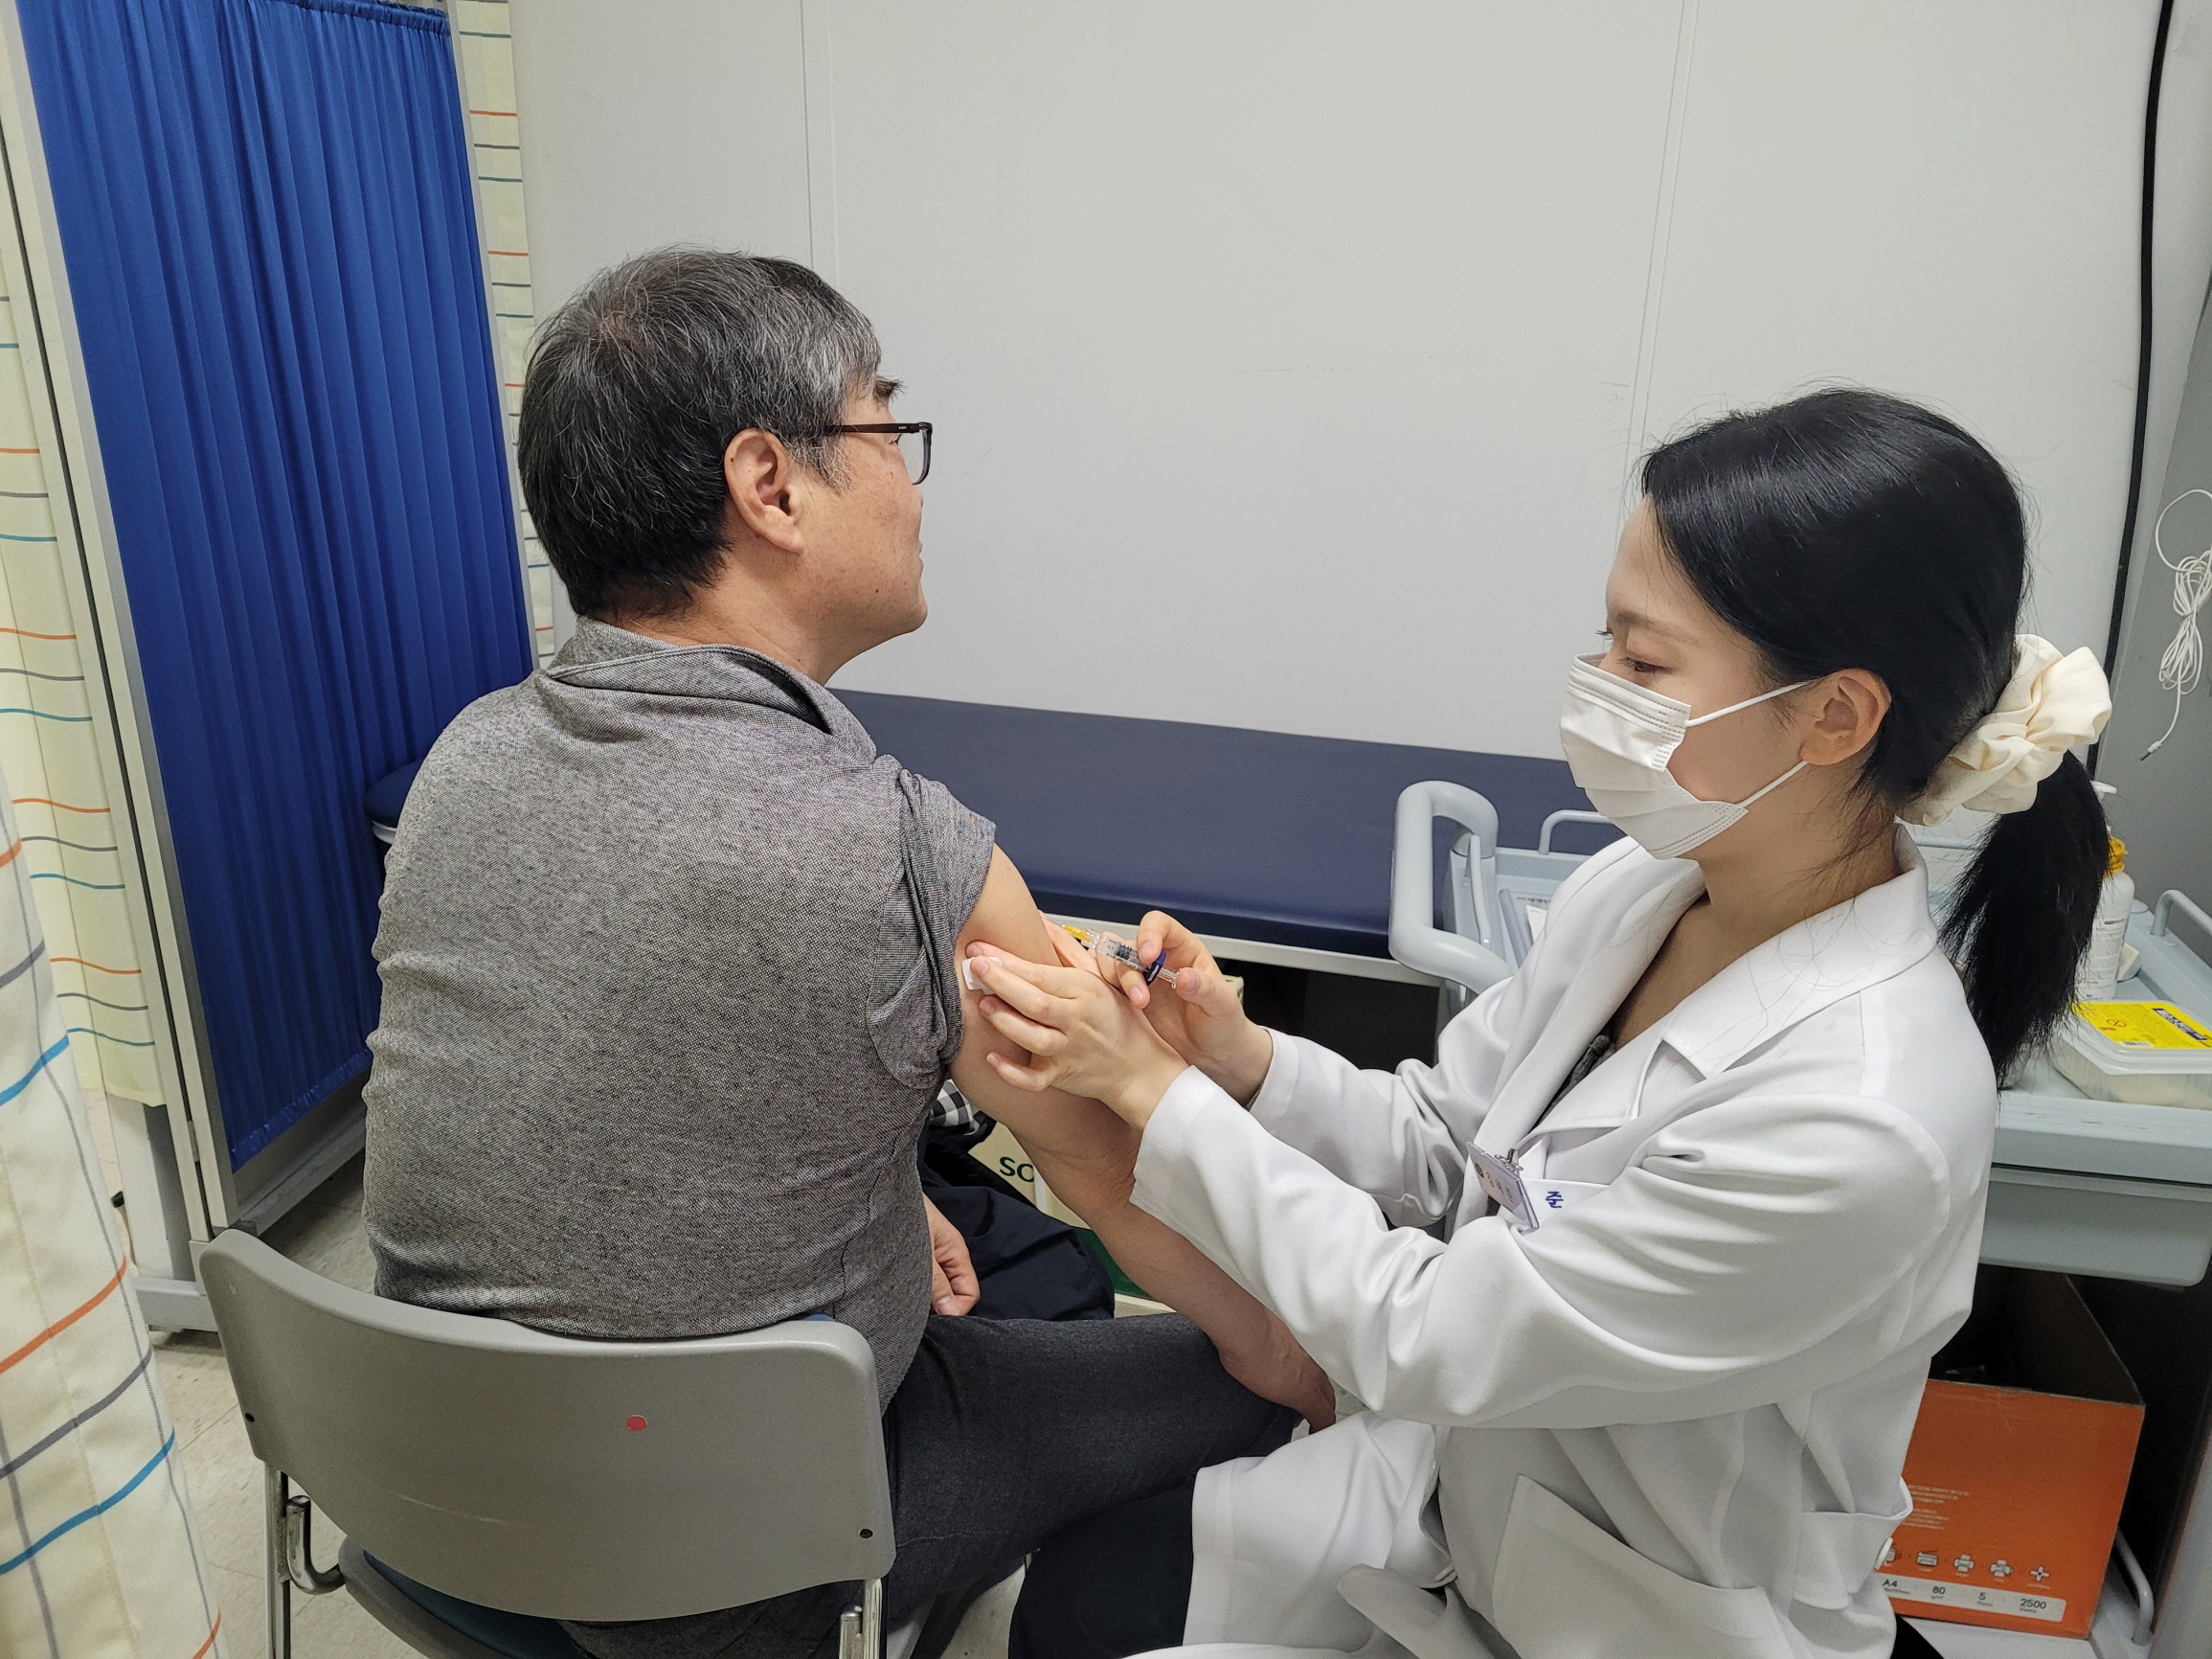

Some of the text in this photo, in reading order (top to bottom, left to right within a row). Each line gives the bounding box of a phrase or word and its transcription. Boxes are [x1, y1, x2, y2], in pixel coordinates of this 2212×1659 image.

[1882, 1579, 1898, 1587] A4
[1932, 1585, 1946, 1595] 80
[1978, 1592, 1987, 1601] 5
[2020, 1598, 2047, 1610] 2500
